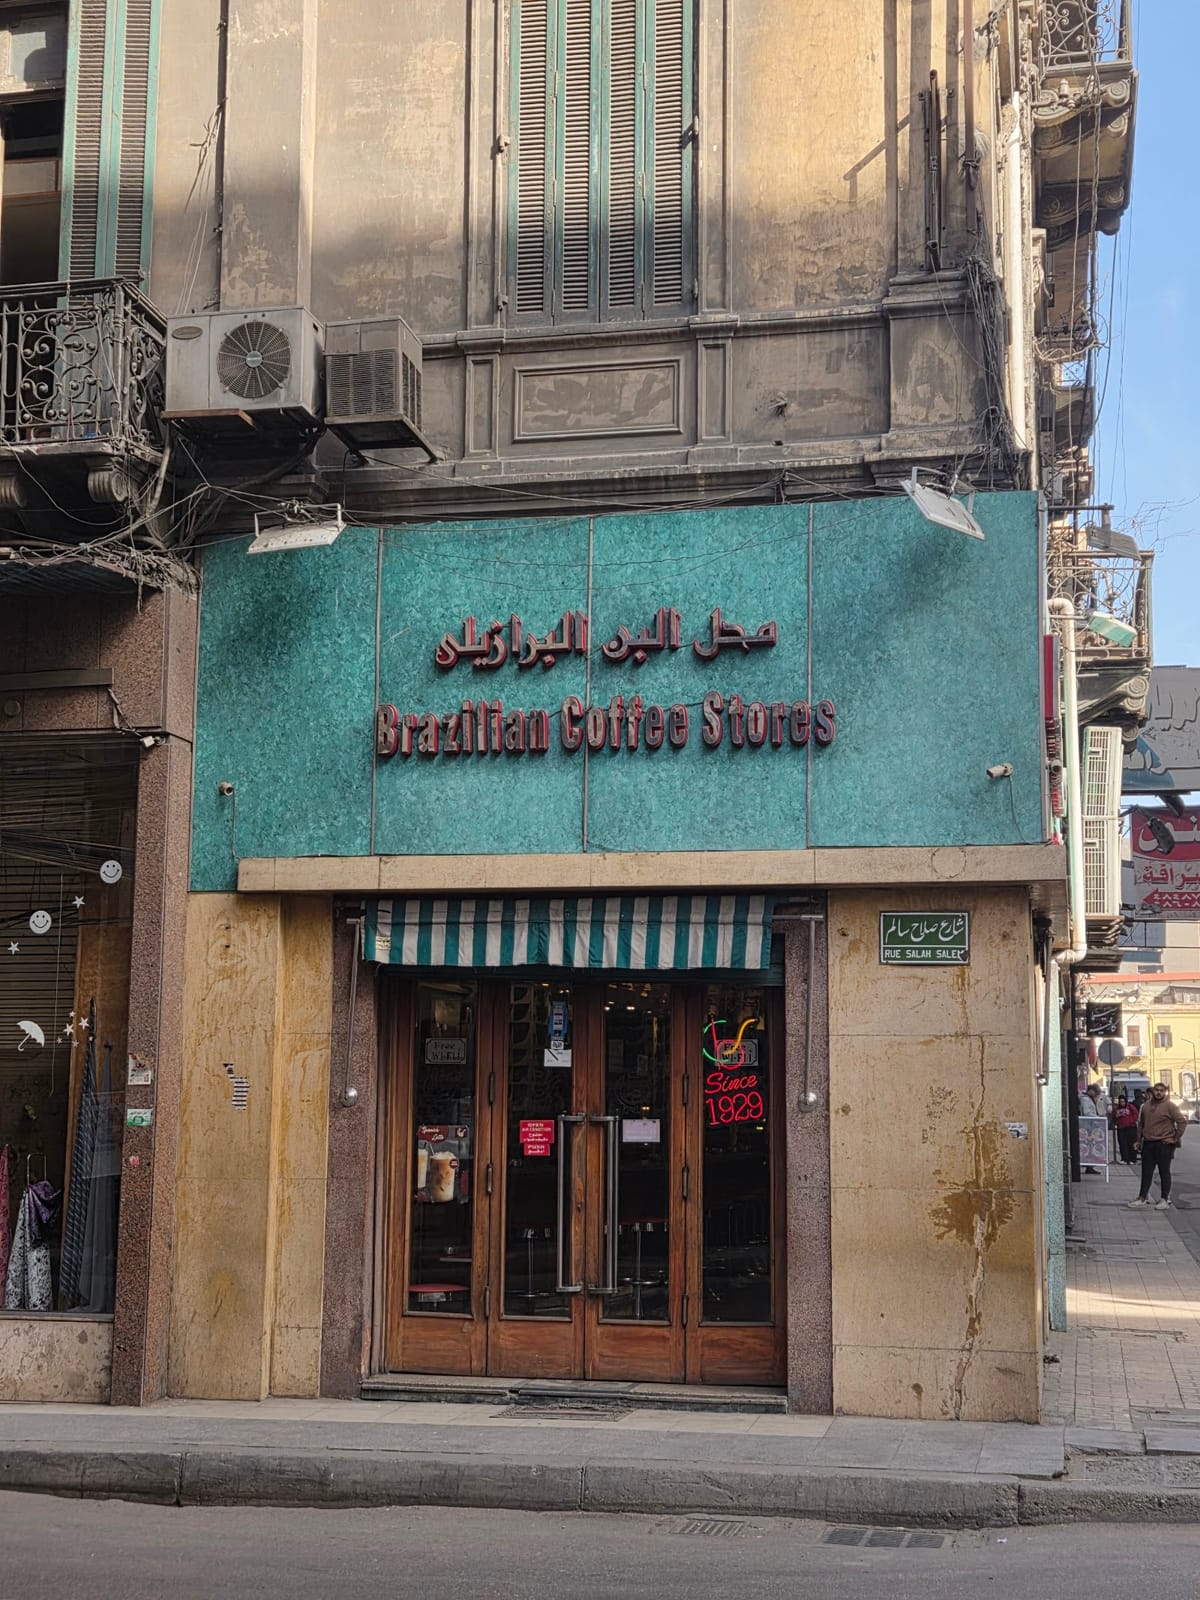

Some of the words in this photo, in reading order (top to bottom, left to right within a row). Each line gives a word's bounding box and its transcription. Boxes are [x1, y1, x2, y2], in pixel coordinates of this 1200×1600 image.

[435, 610, 588, 669] البرازيلى
[602, 607, 680, 664] البن
[693, 607, 777, 659] محل
[376, 698, 549, 756] Brazilian
[560, 694, 689, 750] Coffee
[702, 690, 836, 749] Stores
[885, 917, 910, 944] سالم
[911, 920, 939, 942] صلاح
[938, 917, 964, 942] شارع
[884, 949, 901, 959] RUE
[906, 949, 931, 959] SALAH
[705, 1072, 758, 1094] Since
[706, 1091, 764, 1126] 1929
